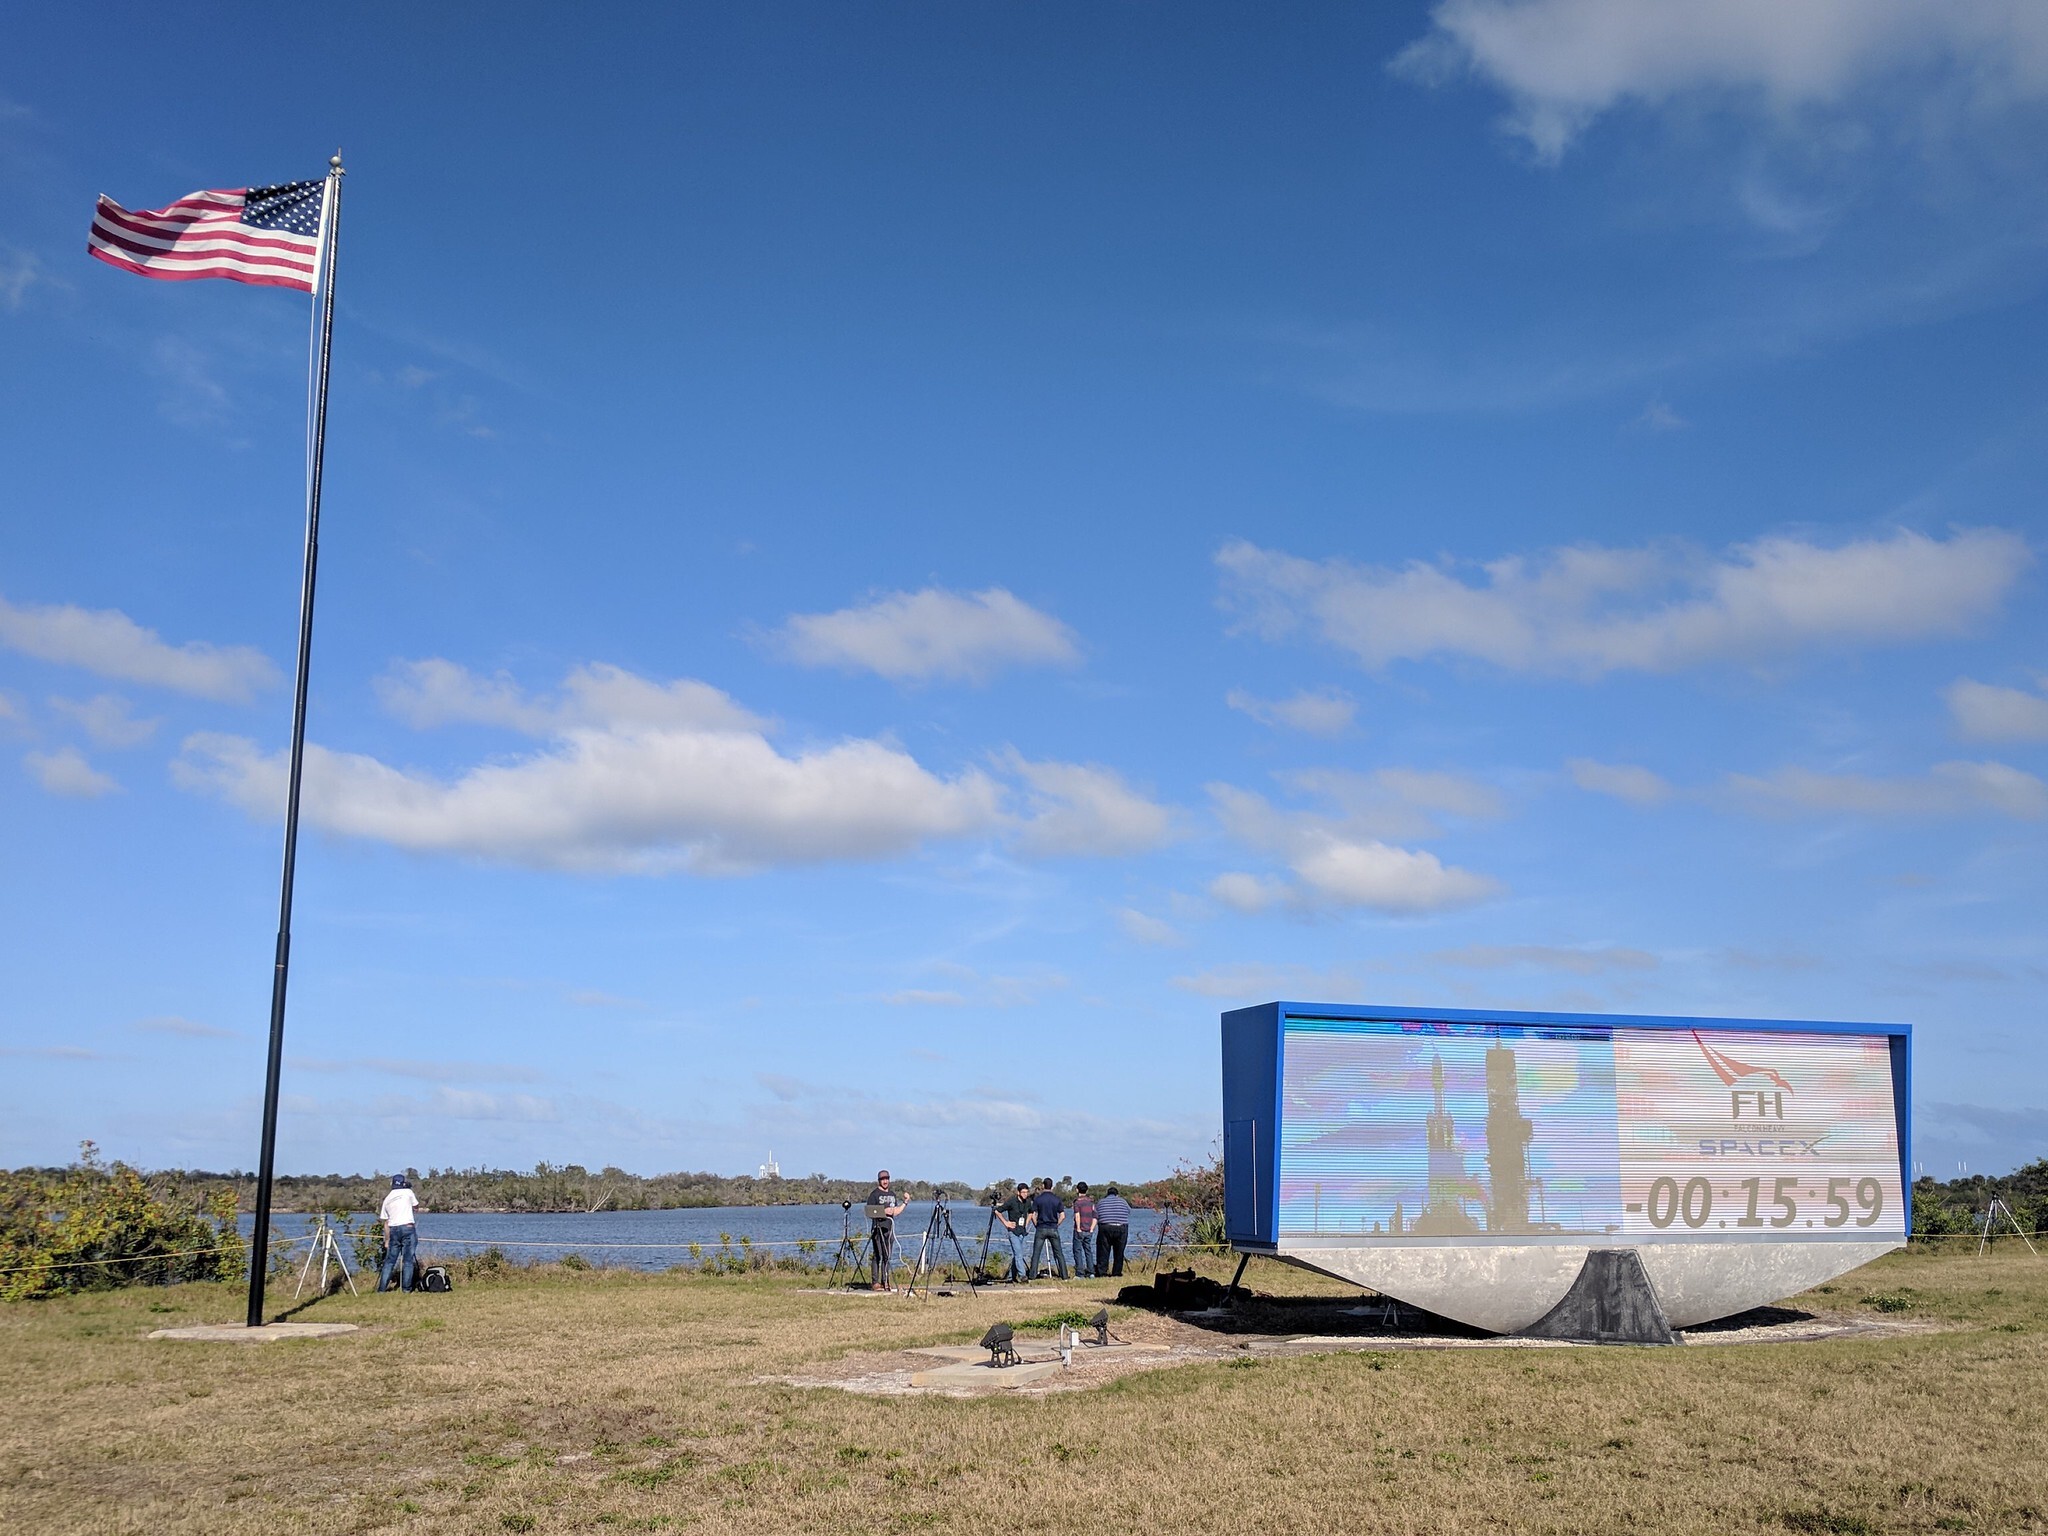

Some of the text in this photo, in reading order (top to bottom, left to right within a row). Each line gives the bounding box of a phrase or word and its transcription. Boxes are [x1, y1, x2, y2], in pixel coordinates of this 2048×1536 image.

[1731, 1090, 1783, 1120] FH
[1699, 1136, 1831, 1157] SPACEX
[1626, 1176, 1884, 1229] -00:15:59
